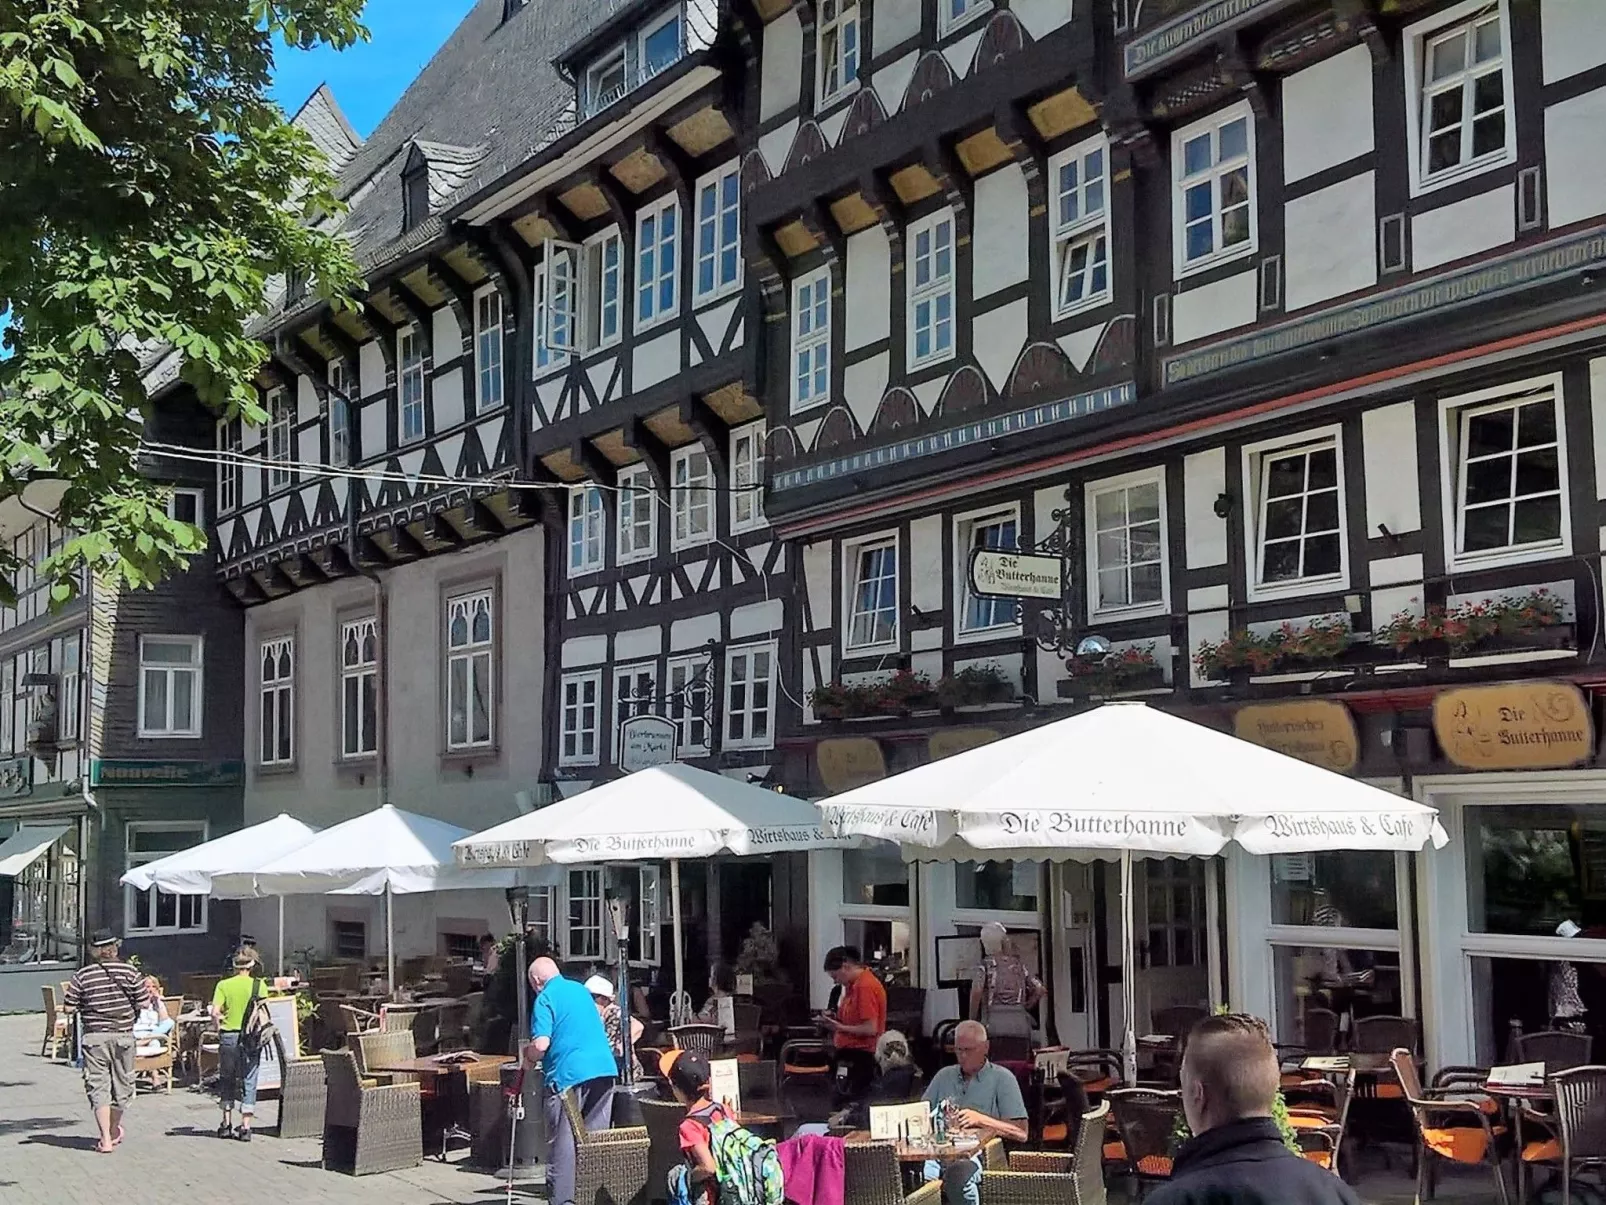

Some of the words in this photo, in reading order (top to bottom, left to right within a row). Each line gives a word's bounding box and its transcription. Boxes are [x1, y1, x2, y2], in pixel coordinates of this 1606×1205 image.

[999, 556, 1018, 568] Die
[995, 569, 1059, 584] Butterhanne
[1498, 706, 1526, 722] Die
[1498, 728, 1584, 748] Butterhanne
[1000, 811, 1040, 834] Die
[1050, 812, 1187, 840] Butterhanne
[1264, 815, 1356, 840] Wirtshaus
[1360, 816, 1377, 836] &
[574, 838, 599, 853] Die
[606, 835, 695, 851] Butterhanne
[748, 827, 810, 845] Wirtshaus
[813, 827, 825, 841] &
